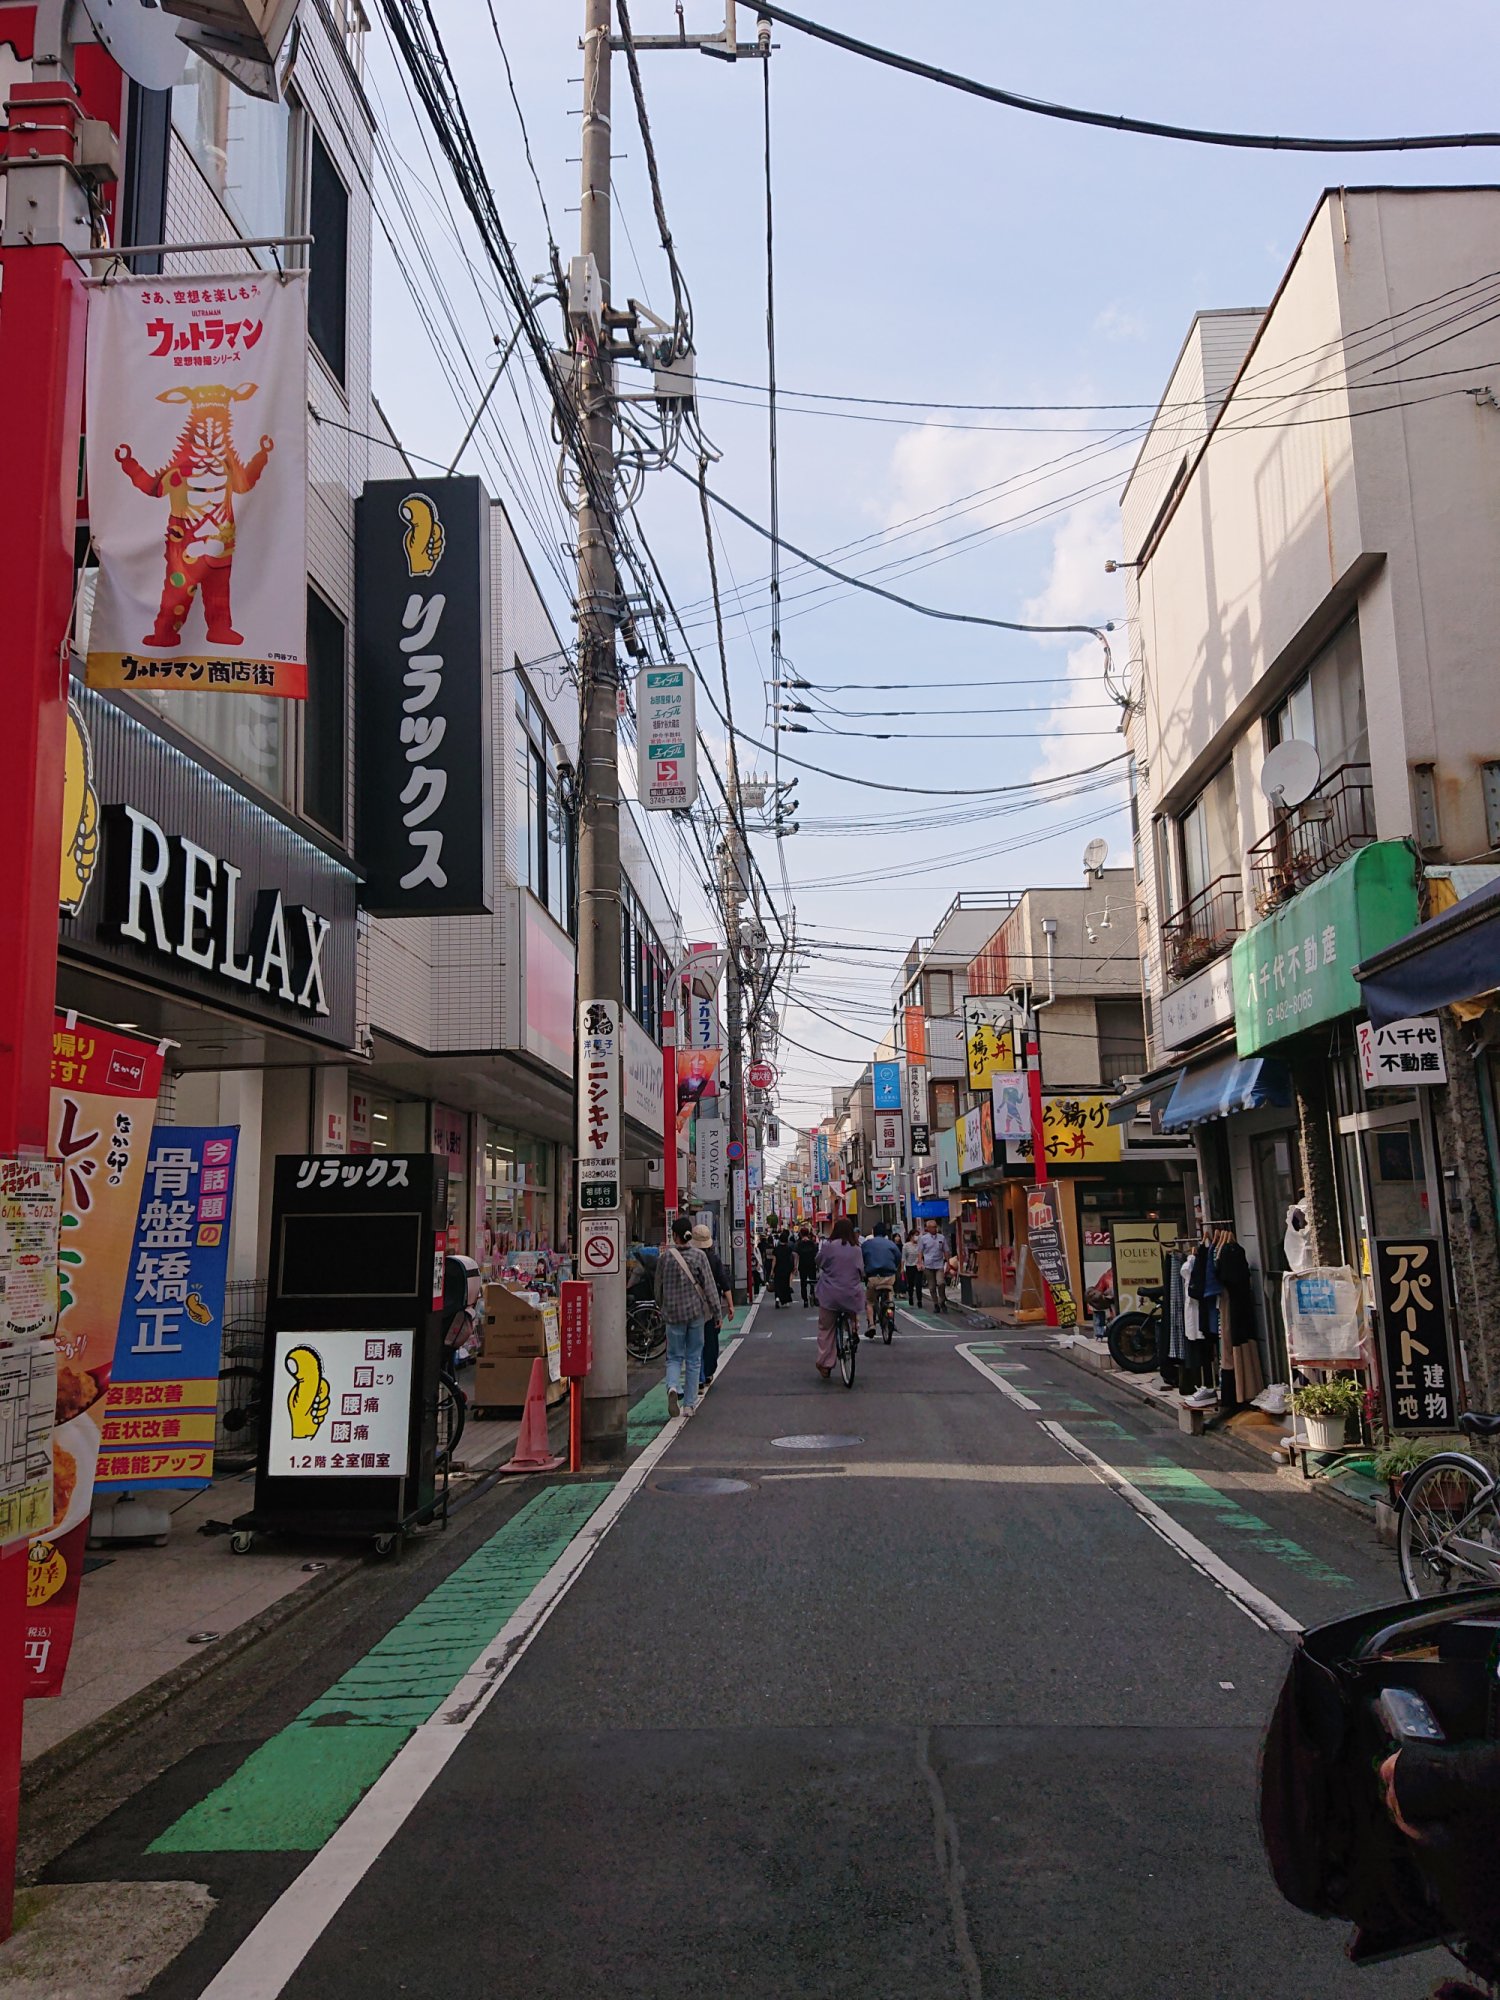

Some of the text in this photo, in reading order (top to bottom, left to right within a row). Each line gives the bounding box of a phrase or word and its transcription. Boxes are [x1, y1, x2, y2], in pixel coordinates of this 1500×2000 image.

[141, 284, 261, 304] さあ、空想を楽しもう。
[191, 309, 221, 317] ULTRAMAN
[146, 317, 264, 356] ウルトラマン
[173, 351, 241, 367] 空想特撮シリーズ
[121, 656, 275, 687] ウルトラマン商店街
[399, 593, 448, 890] リラックス
[121, 804, 330, 1016] RELAX
[1247, 924, 1336, 1008] 八千代不動産
[54, 1033, 94, 1060] 帰り
[1377, 1027, 1437, 1047] 八千代
[1360, 1028, 1374, 1082] アパート
[1380, 1052, 1440, 1072] 不動産
[112, 1060, 141, 1078] なか卯
[751, 1072, 771, 1081] 消火栓
[588, 1062, 609, 1150] ニシキヤ
[108, 1114, 131, 1185] なか卯の
[296, 1158, 410, 1189] リラックス
[710, 1141, 719, 1189] VOYAGE
[200, 1143, 230, 1243] 今話題の
[586, 1187, 611, 1196] 祖師谷
[586, 1198, 611, 1206] 3-33
[131, 1147, 198, 1354] 骨盤矯正
[1385, 1245, 1434, 1366] アパート
[364, 1339, 403, 1361] 頭痛
[354, 1366, 395, 1388] 肩こり
[105, 1384, 184, 1405] 姿勢改善
[1395, 1370, 1418, 1420] 土地
[1423, 1363, 1448, 1420] 建物
[341, 1394, 379, 1415] 腰痛
[101, 1417, 182, 1440] 症状改善
[331, 1420, 370, 1443] 膝痛
[330, 1453, 390, 1469] 全室個室
[28, 1561, 60, 1584] リ辛
